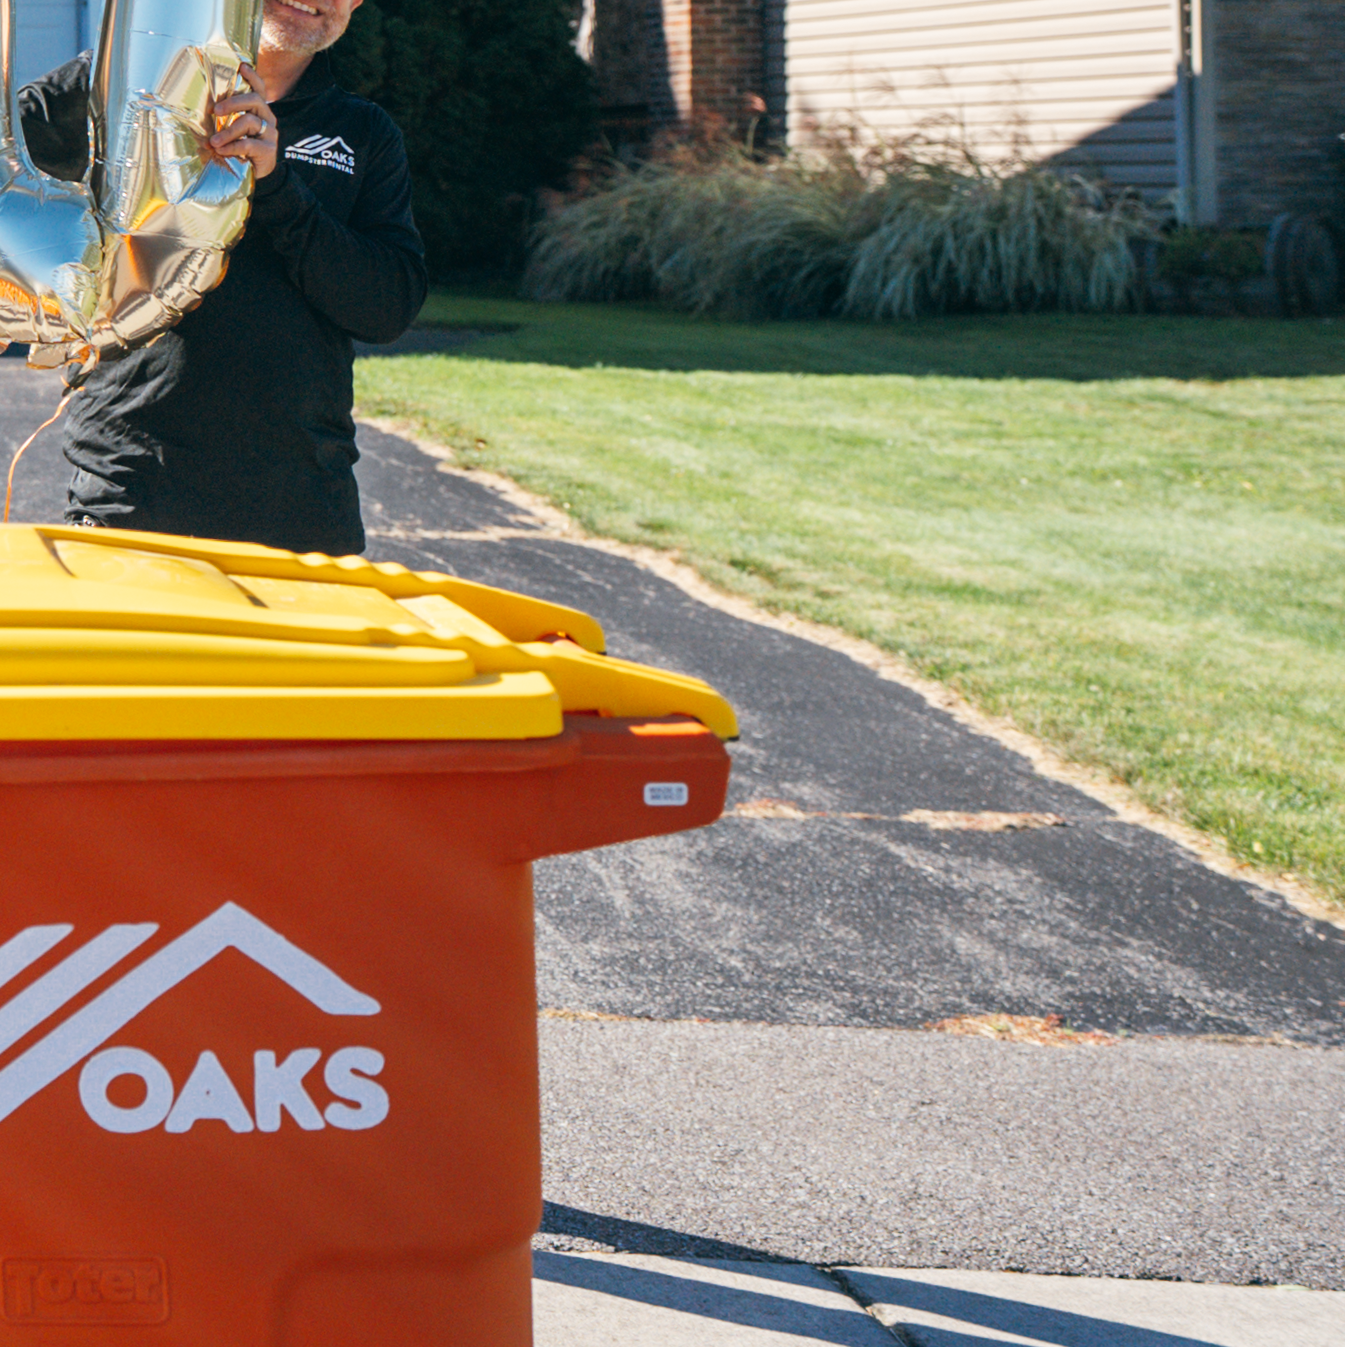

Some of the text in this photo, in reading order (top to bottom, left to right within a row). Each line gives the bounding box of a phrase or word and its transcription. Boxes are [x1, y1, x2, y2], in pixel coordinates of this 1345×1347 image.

[284, 151, 355, 175] DUMPSTER RENTAL
[321, 149, 355, 167] OAKS
[78, 1045, 390, 1134] OAKS
